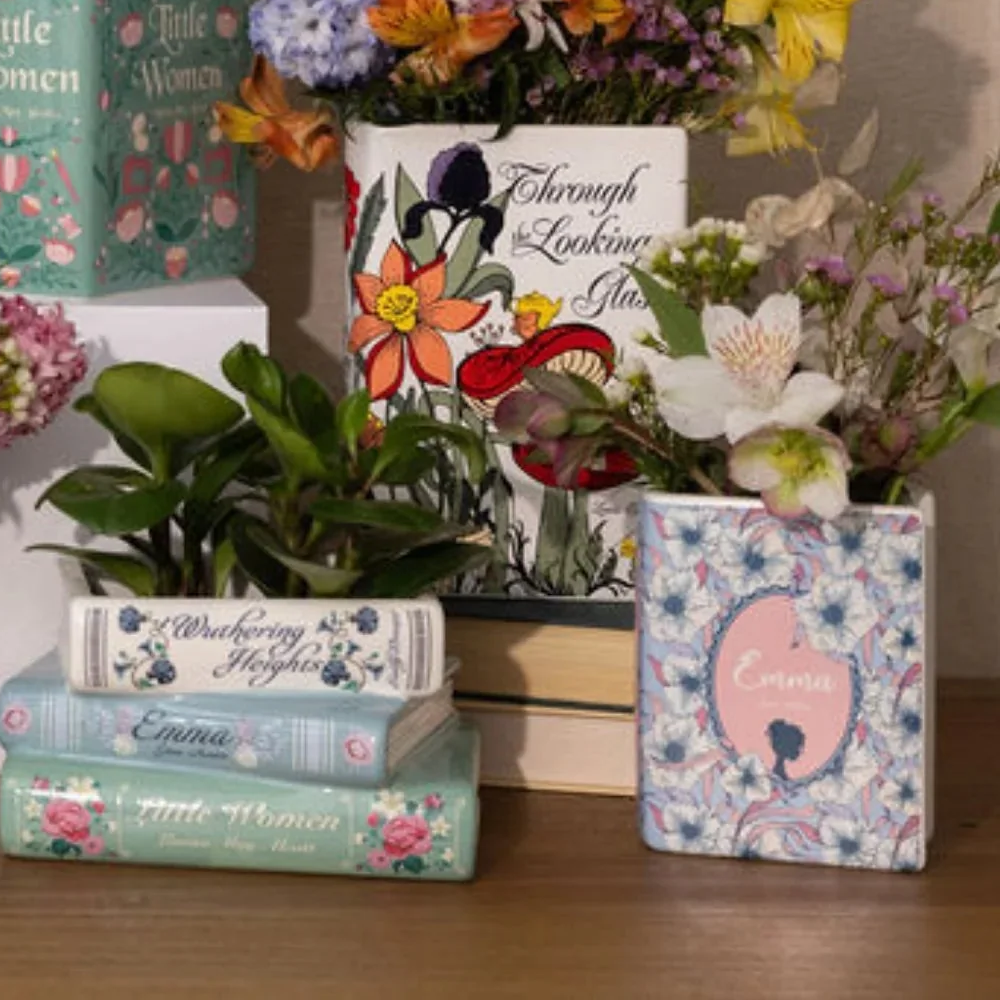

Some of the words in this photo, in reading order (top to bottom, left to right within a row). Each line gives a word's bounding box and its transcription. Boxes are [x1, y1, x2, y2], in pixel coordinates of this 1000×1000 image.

[131, 56, 222, 99] Women
[498, 162, 651, 217] Through
[571, 268, 650, 319] Glas
[170, 606, 305, 655] Wuthering
[213, 642, 323, 687] Heights
[733, 649, 837, 693] Emma
[131, 709, 233, 746] Emma
[222, 800, 341, 832] Women
